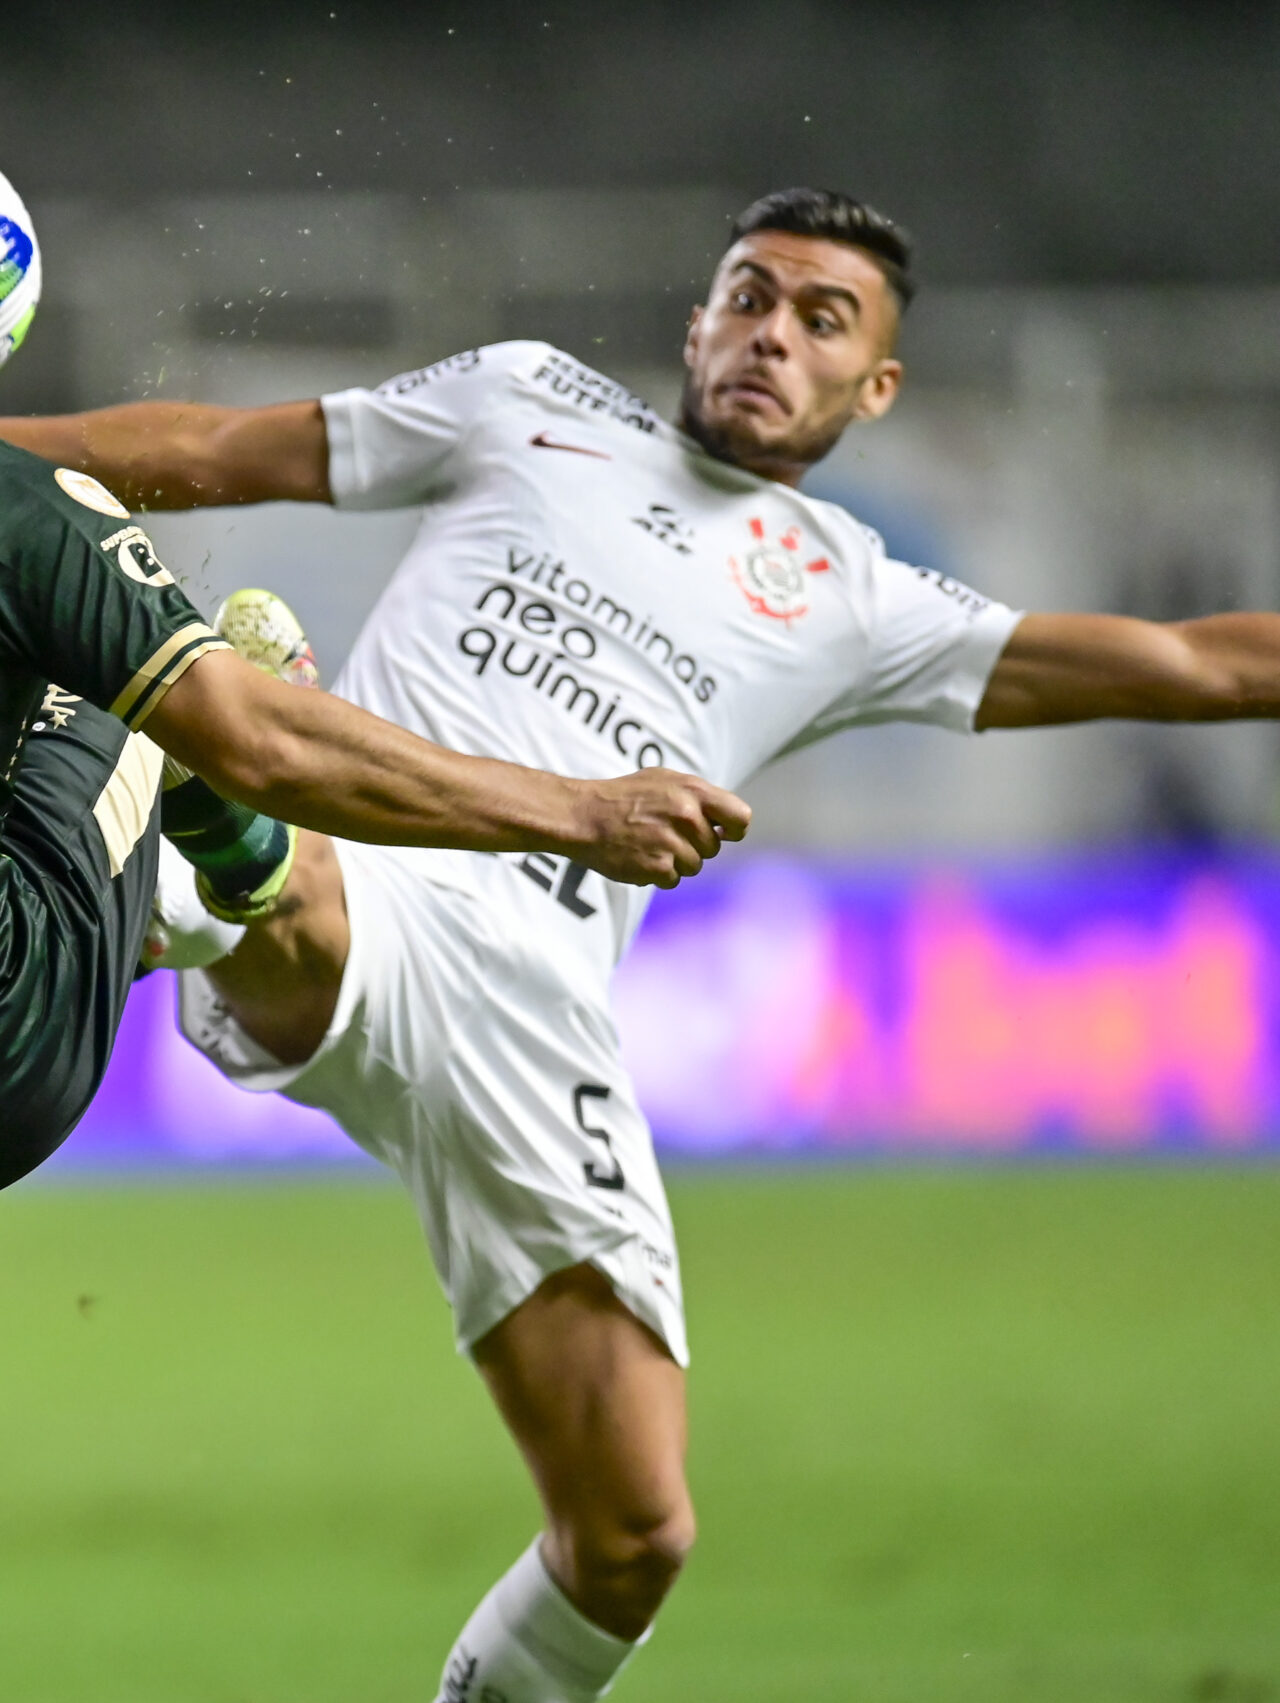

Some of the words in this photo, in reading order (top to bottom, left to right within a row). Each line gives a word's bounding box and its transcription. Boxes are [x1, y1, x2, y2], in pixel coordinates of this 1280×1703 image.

[475, 582, 597, 660] neo
[507, 546, 718, 704] vitaminas
[457, 627, 664, 769] químico
[573, 1084, 625, 1190] 5
